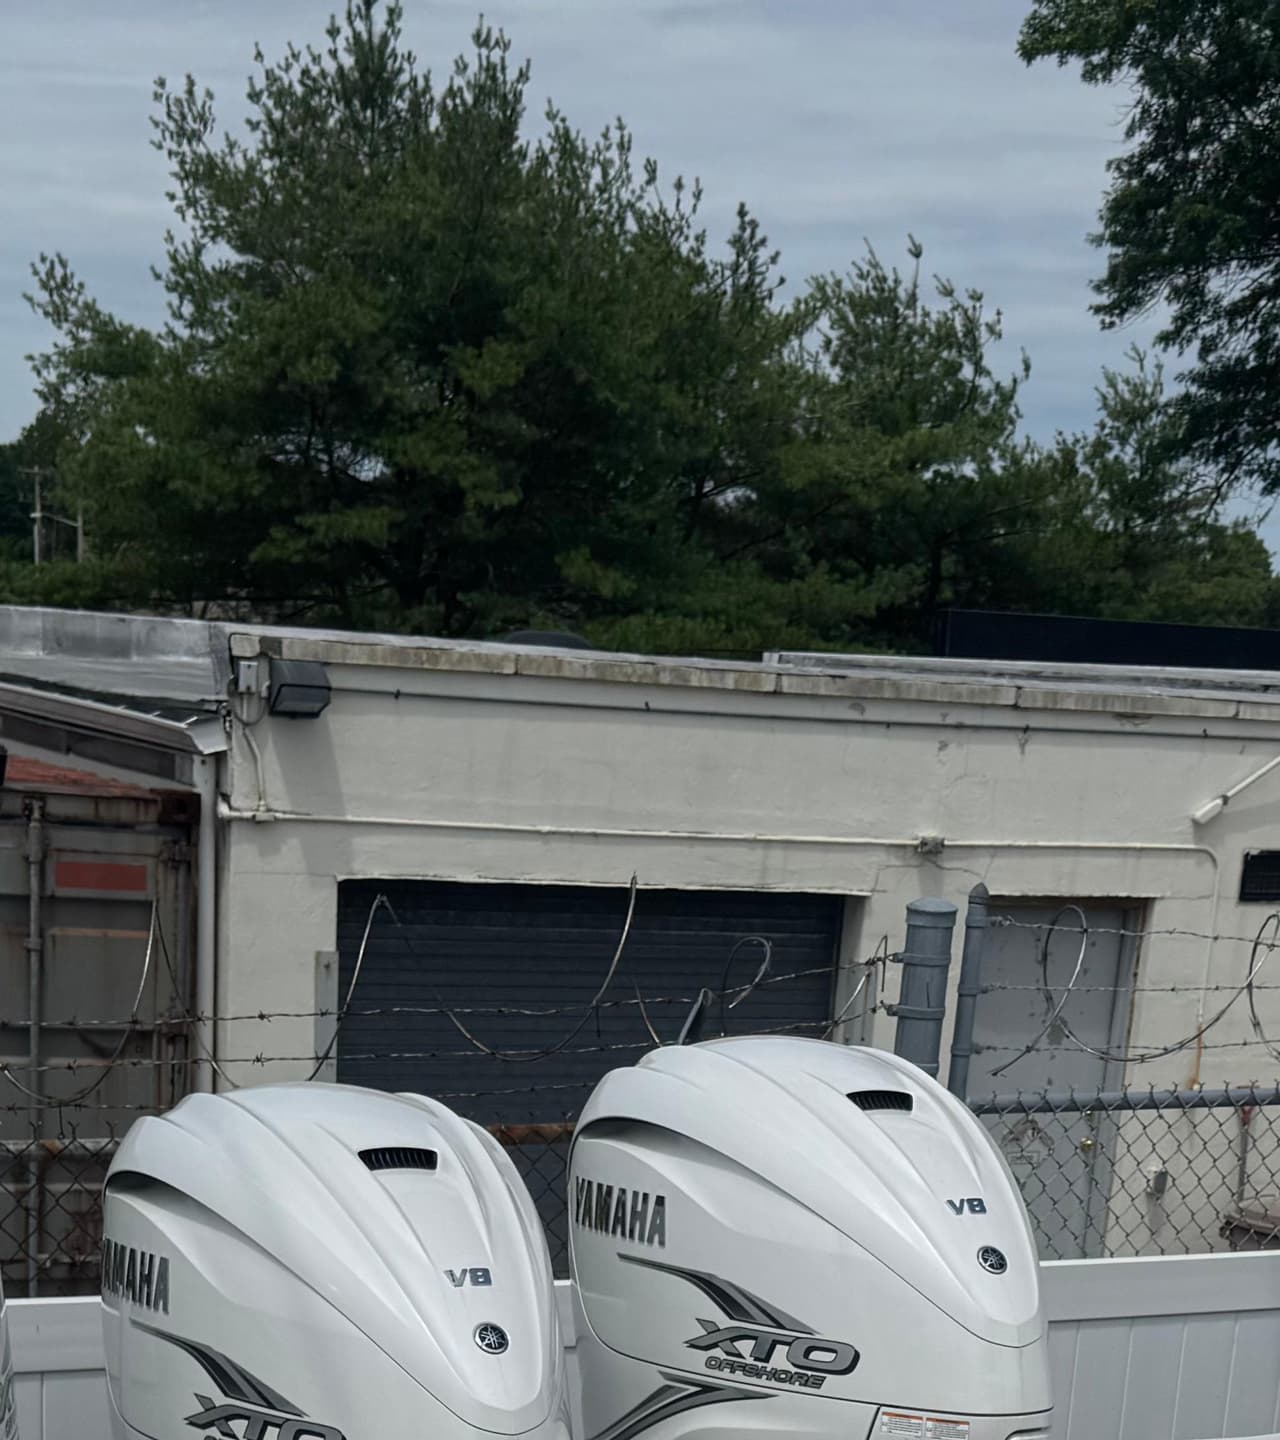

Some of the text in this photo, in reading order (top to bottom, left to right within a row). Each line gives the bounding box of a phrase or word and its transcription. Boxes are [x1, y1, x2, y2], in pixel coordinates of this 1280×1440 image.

[575, 1175, 666, 1248] YAMAHA
[945, 1197, 988, 1216] V8
[442, 1267, 493, 1288] V8
[682, 1317, 861, 1376] XTO
[704, 1355, 827, 1389] OFFSHORE
